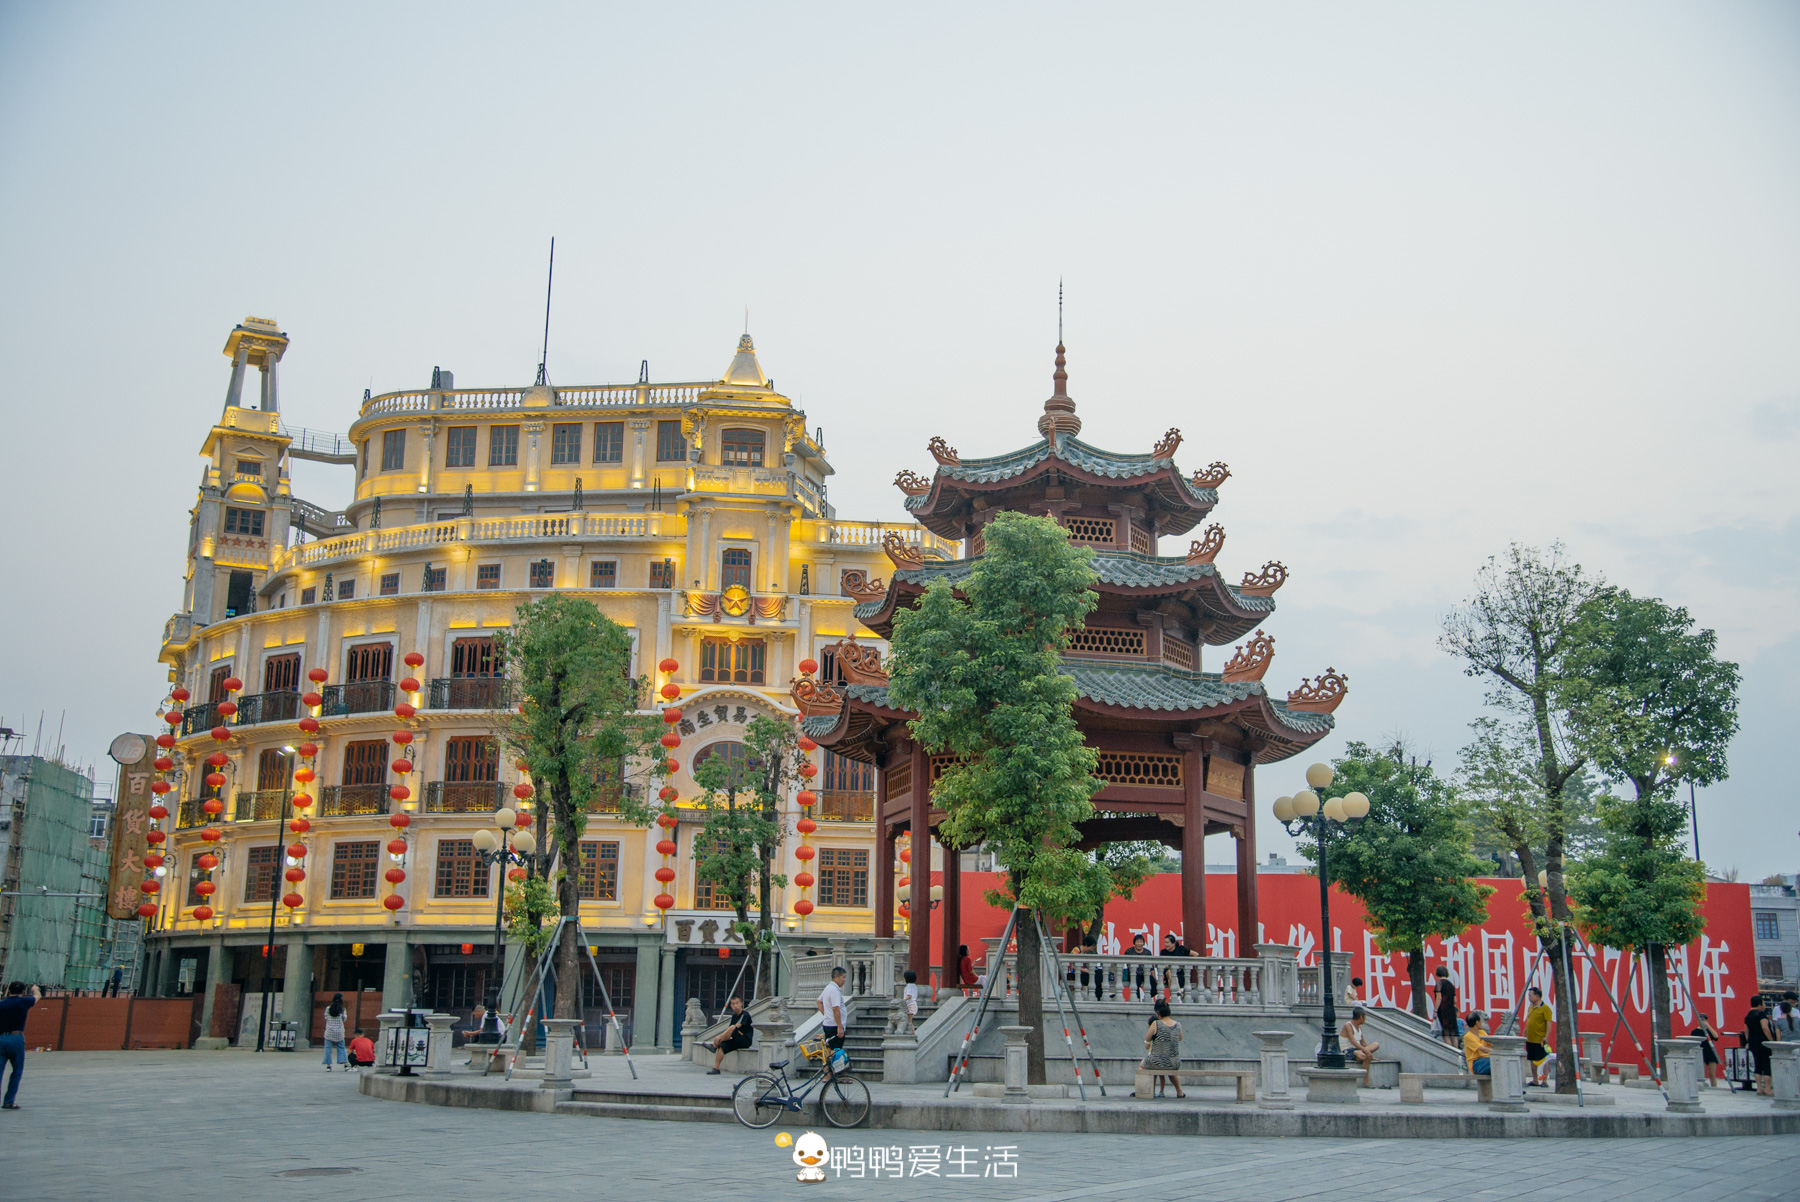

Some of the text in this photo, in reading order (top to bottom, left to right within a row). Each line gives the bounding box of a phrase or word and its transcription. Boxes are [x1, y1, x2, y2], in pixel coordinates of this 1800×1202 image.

[678, 704, 761, 737] 南生貿易
[674, 918, 761, 944] 百貨大
[1096, 921, 1735, 1029] 民共和国成立70周年
